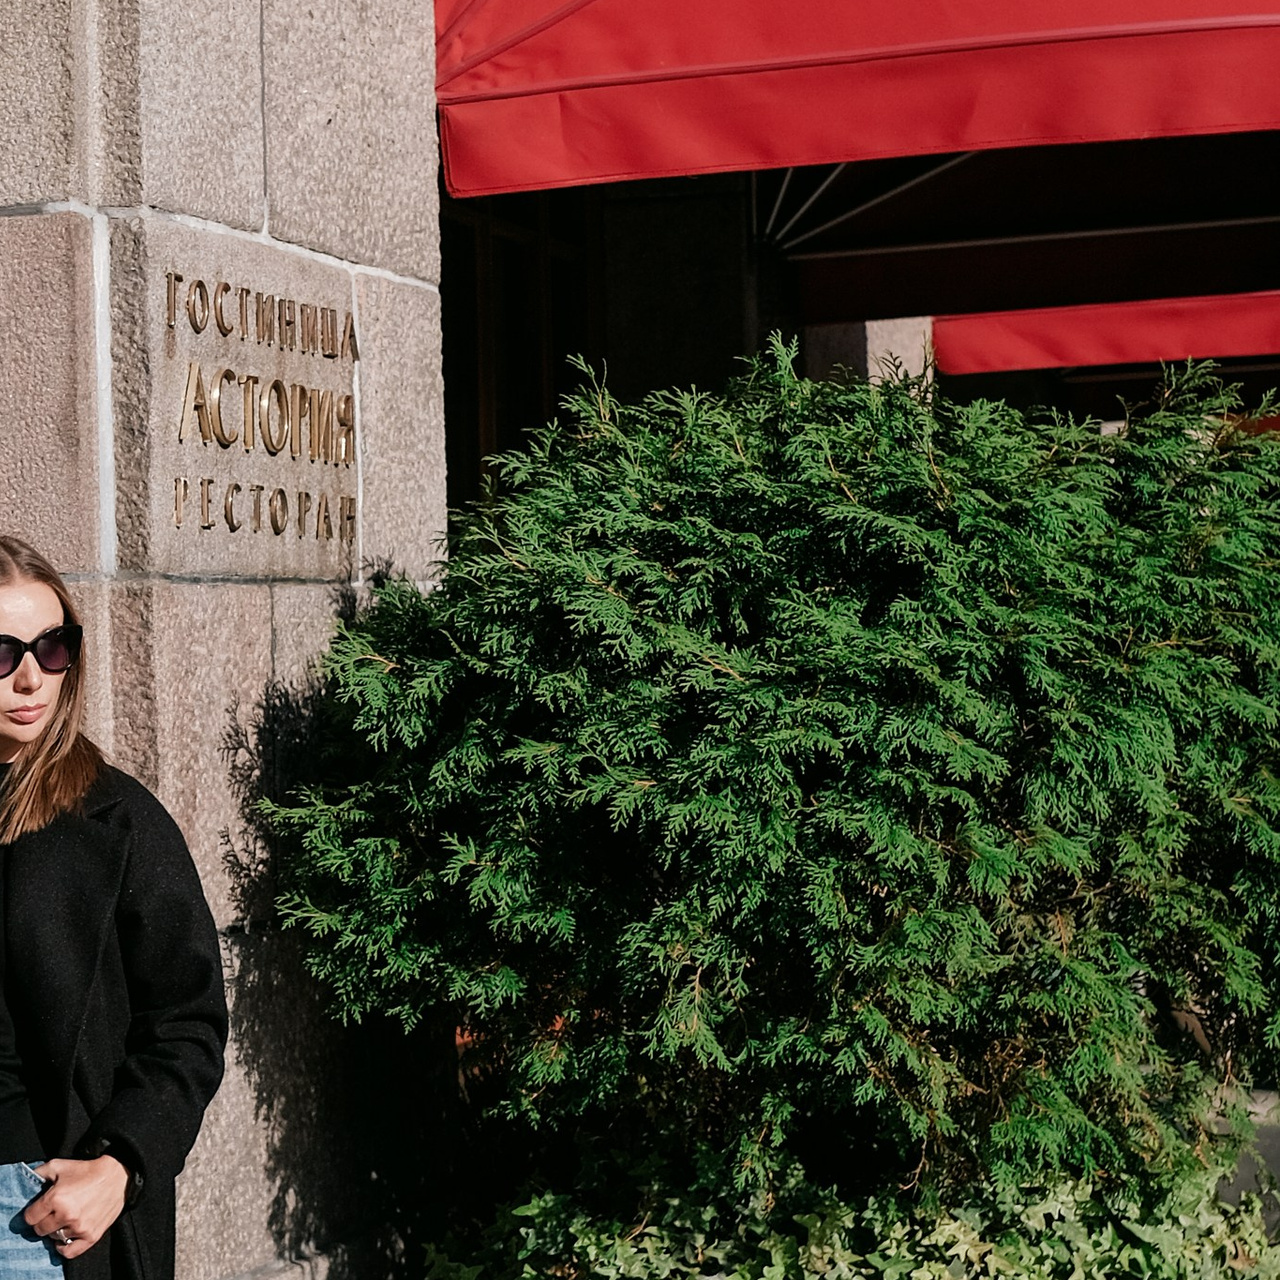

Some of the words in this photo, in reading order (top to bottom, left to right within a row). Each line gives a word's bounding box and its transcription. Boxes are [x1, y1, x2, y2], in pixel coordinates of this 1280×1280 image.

[166, 272, 359, 361] ГОСТИНИЦА
[179, 362, 355, 467] АСТОРИЯ
[174, 477, 356, 540] РЕСТОРАН
